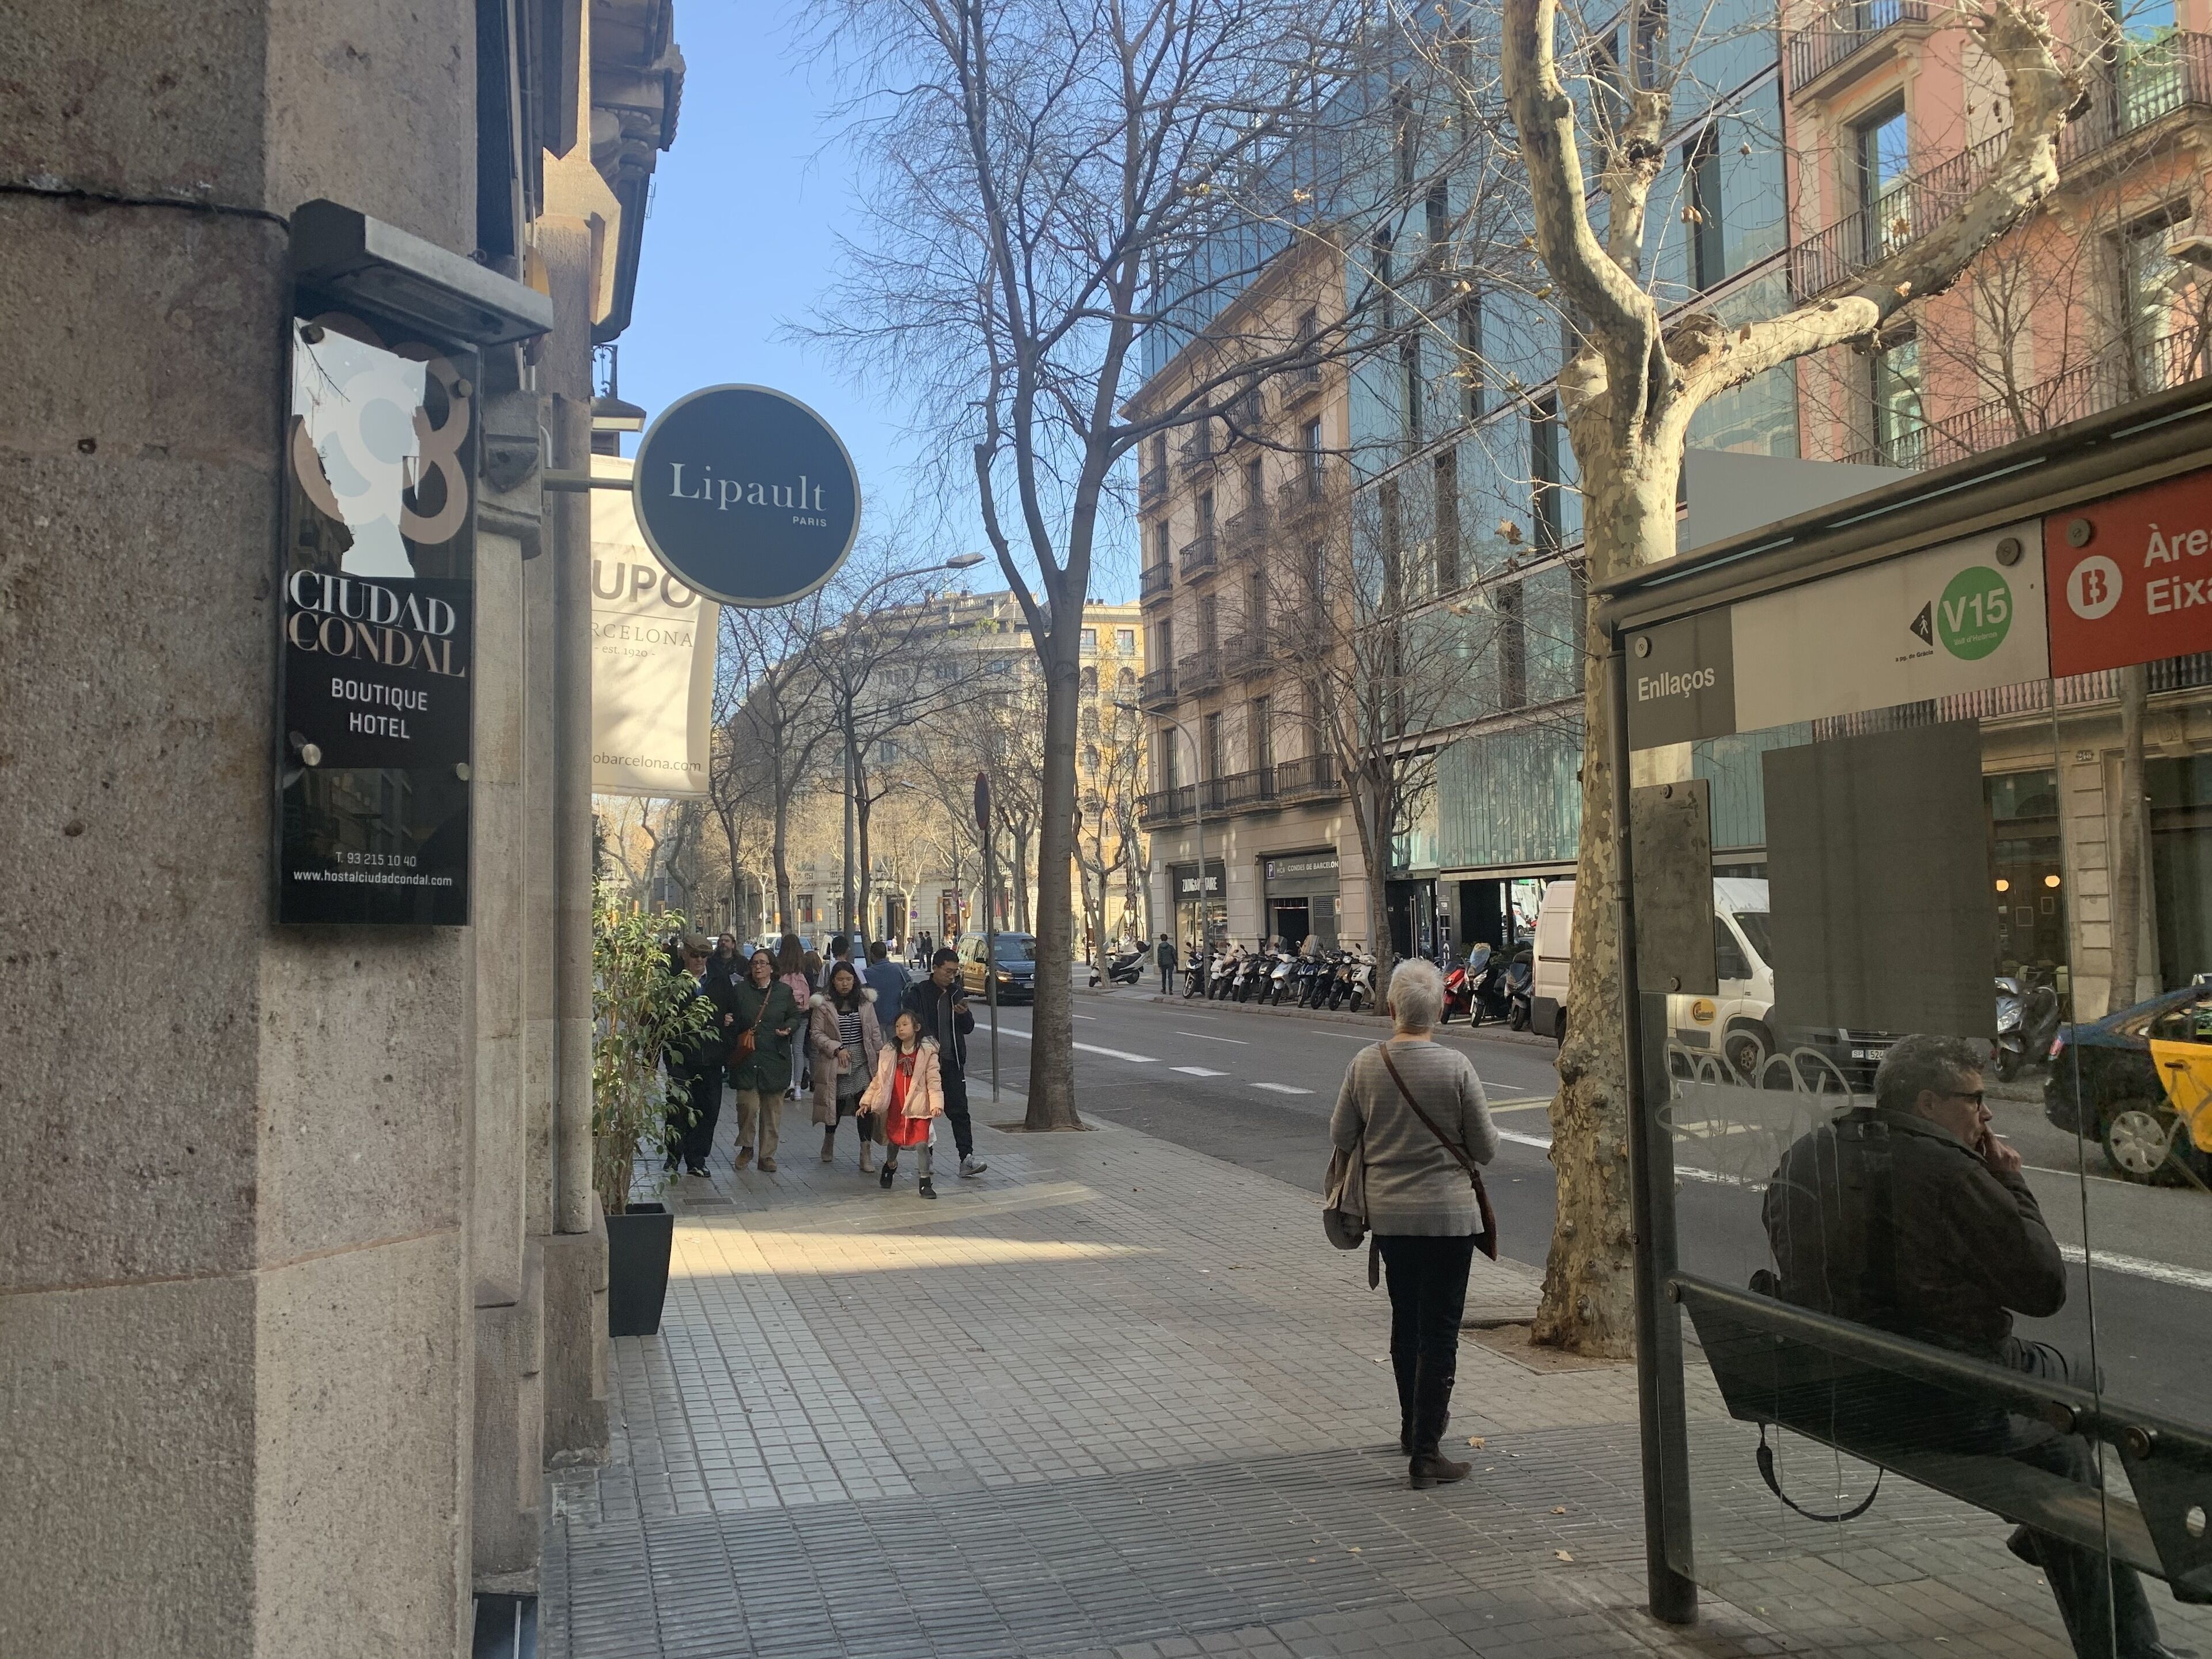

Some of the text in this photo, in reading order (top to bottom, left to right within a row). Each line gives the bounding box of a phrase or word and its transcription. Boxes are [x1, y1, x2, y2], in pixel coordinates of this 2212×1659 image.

[668, 462, 827, 512] Lipault
[793, 516, 827, 527] PARIS
[2143, 523, 2212, 568] Àre
[289, 569, 456, 636] CIUDAD
[1942, 588, 2008, 632] V15
[2146, 575, 2212, 615] Eix
[289, 611, 466, 677] CONDAL
[602, 645, 648, 658] est. 1920
[331, 677, 428, 711] BOUTIQUE
[1638, 668, 1715, 702] Enllaços
[349, 712, 410, 739] HOTEL
[335, 852, 417, 867] T. 93 215 10 40
[1287, 864, 1305, 872] CONDES
[293, 870, 452, 886] www.hostalciudadcondal.com
